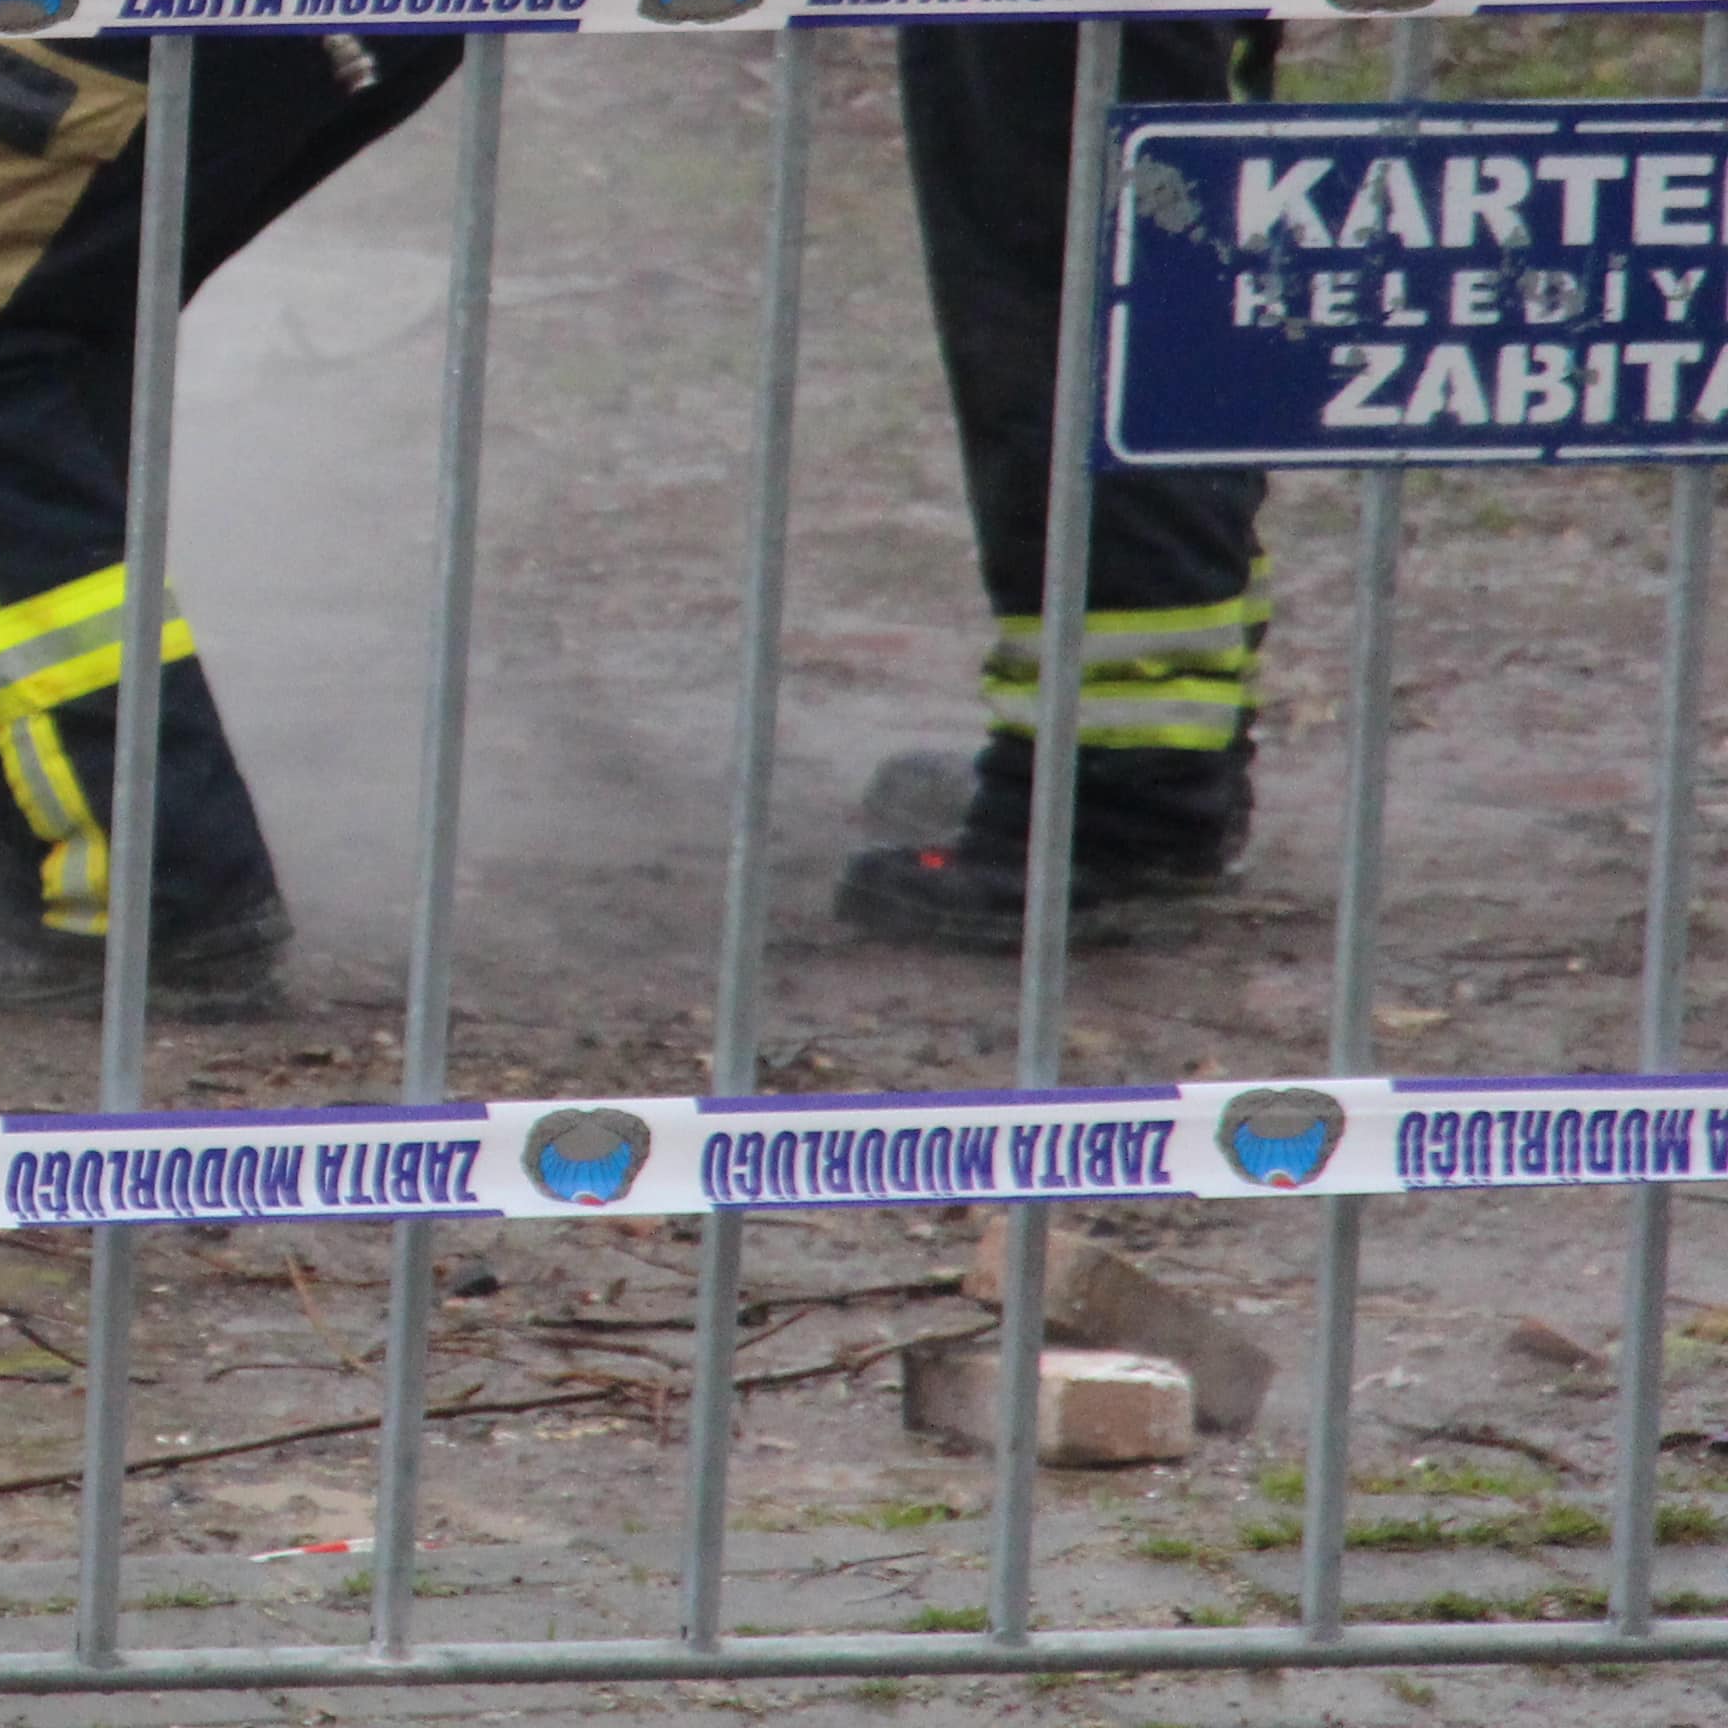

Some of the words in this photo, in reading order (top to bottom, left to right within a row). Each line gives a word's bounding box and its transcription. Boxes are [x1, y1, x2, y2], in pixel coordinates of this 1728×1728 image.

[1234, 154, 1728, 250] KARTE
[314, 1139, 483, 1206] ZABITA
[1009, 1118, 1177, 1191] ZABITA
